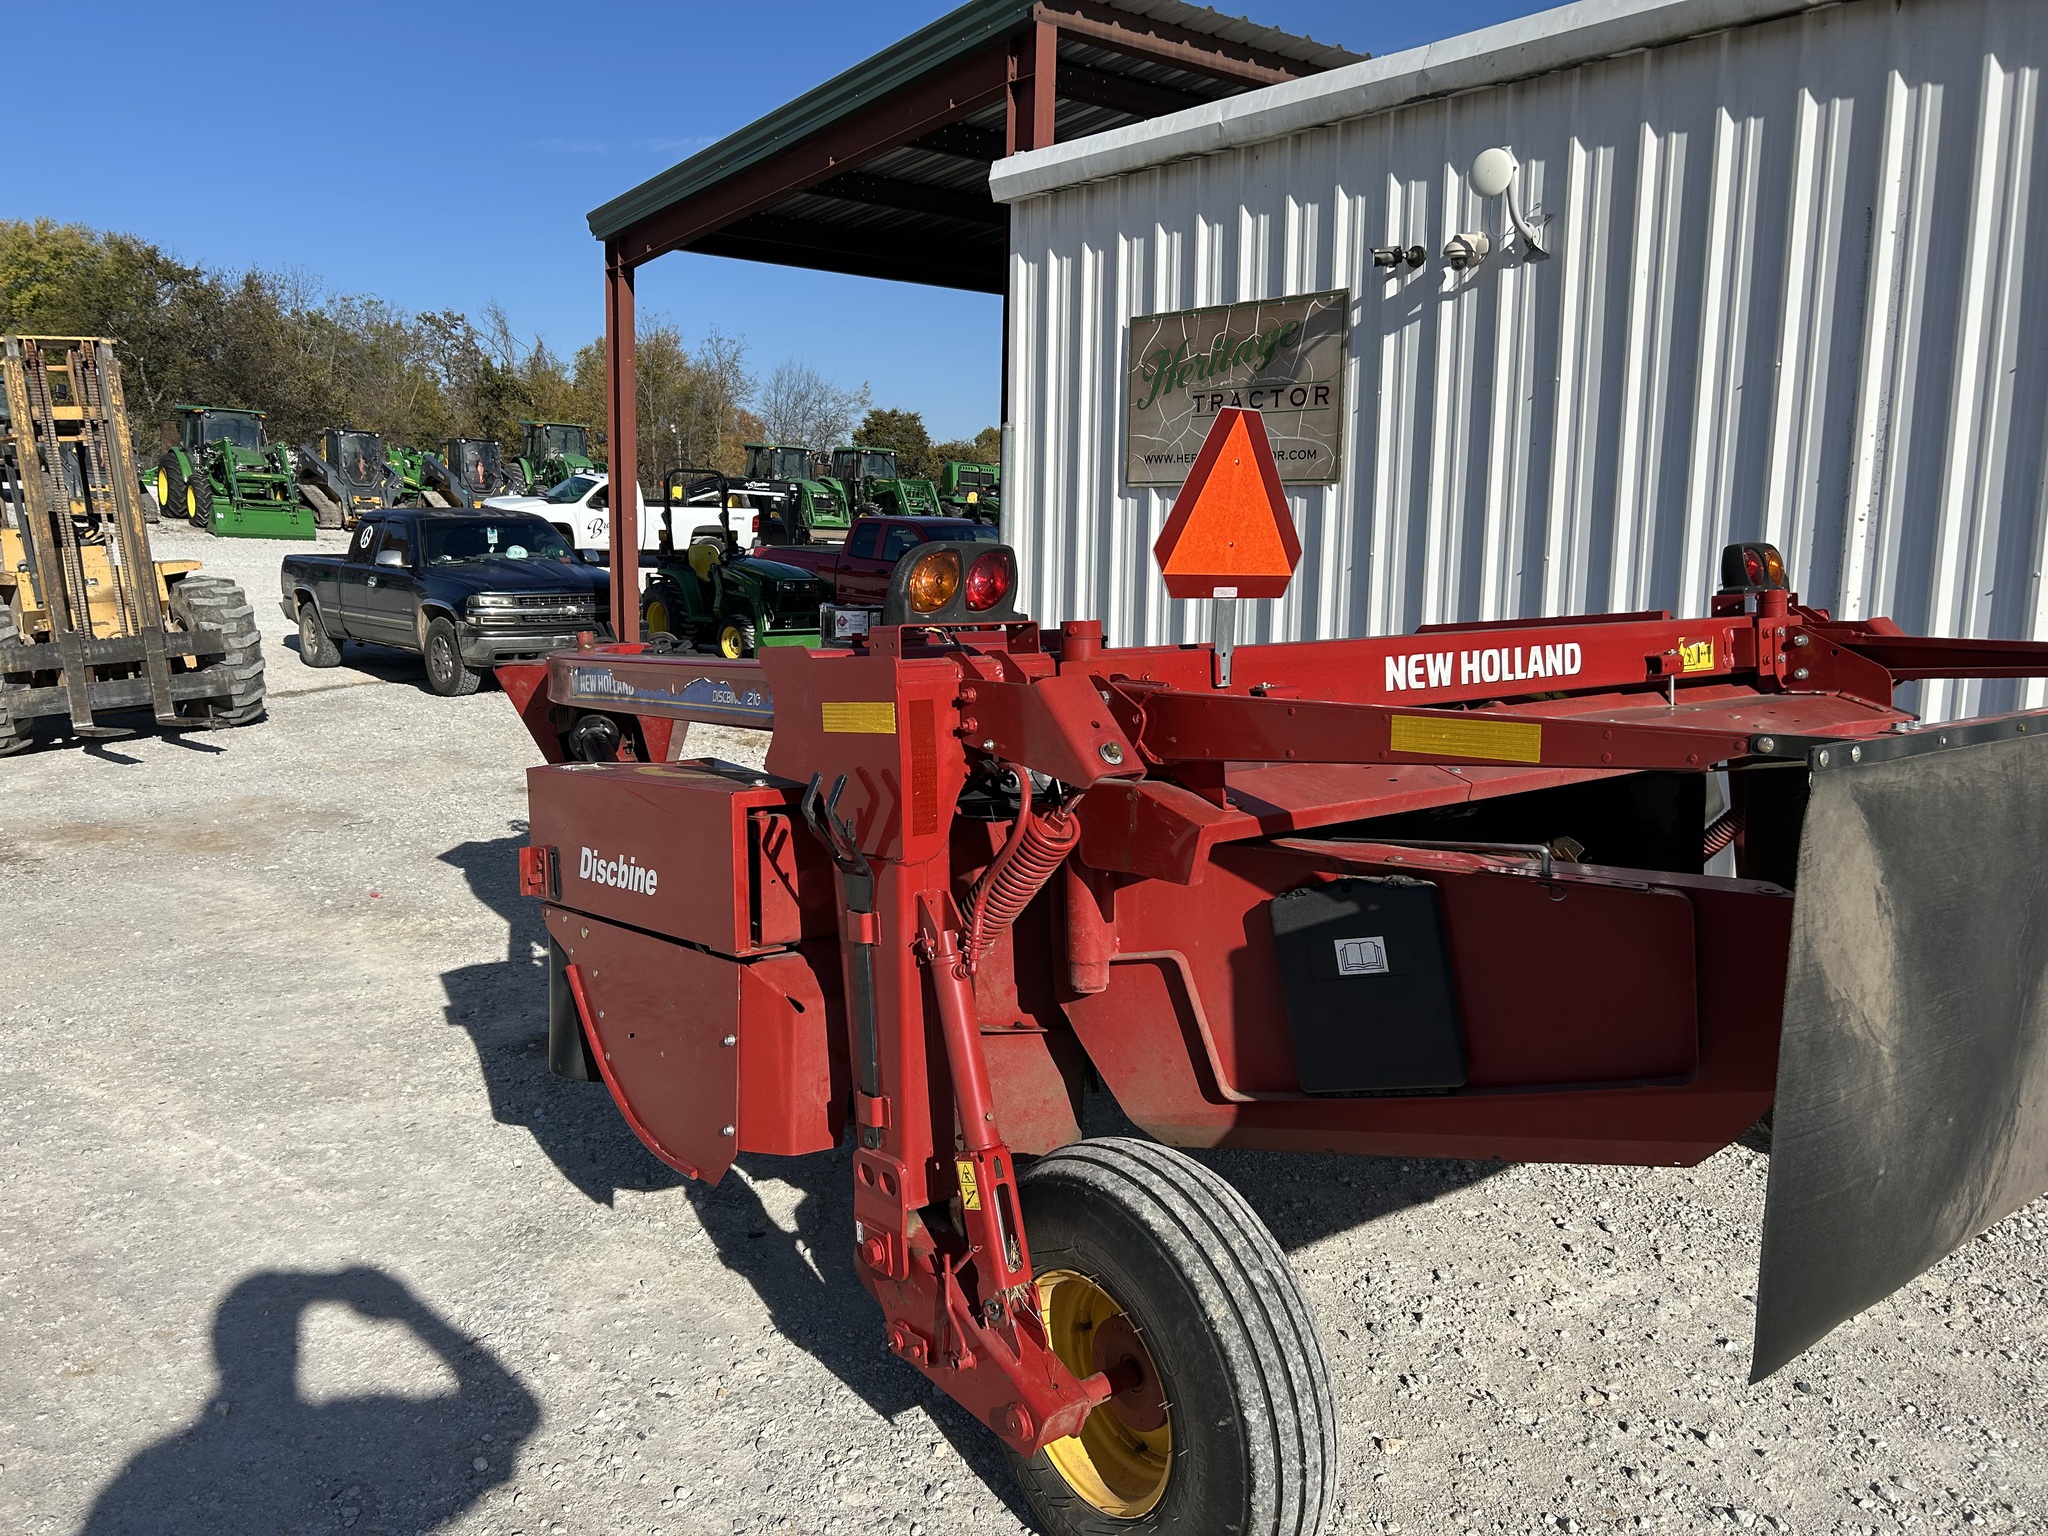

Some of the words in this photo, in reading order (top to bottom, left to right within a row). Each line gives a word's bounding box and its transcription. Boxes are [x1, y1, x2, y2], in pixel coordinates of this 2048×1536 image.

[1137, 319, 1301, 411] Heritage
[1192, 386, 1330, 413] TRACTOR
[580, 674, 597, 692] NEW
[1385, 652, 1453, 692] NEW
[1460, 643, 1582, 686] HOLLAND
[712, 690, 741, 704] DISCBIN
[579, 846, 658, 896] Discbine
